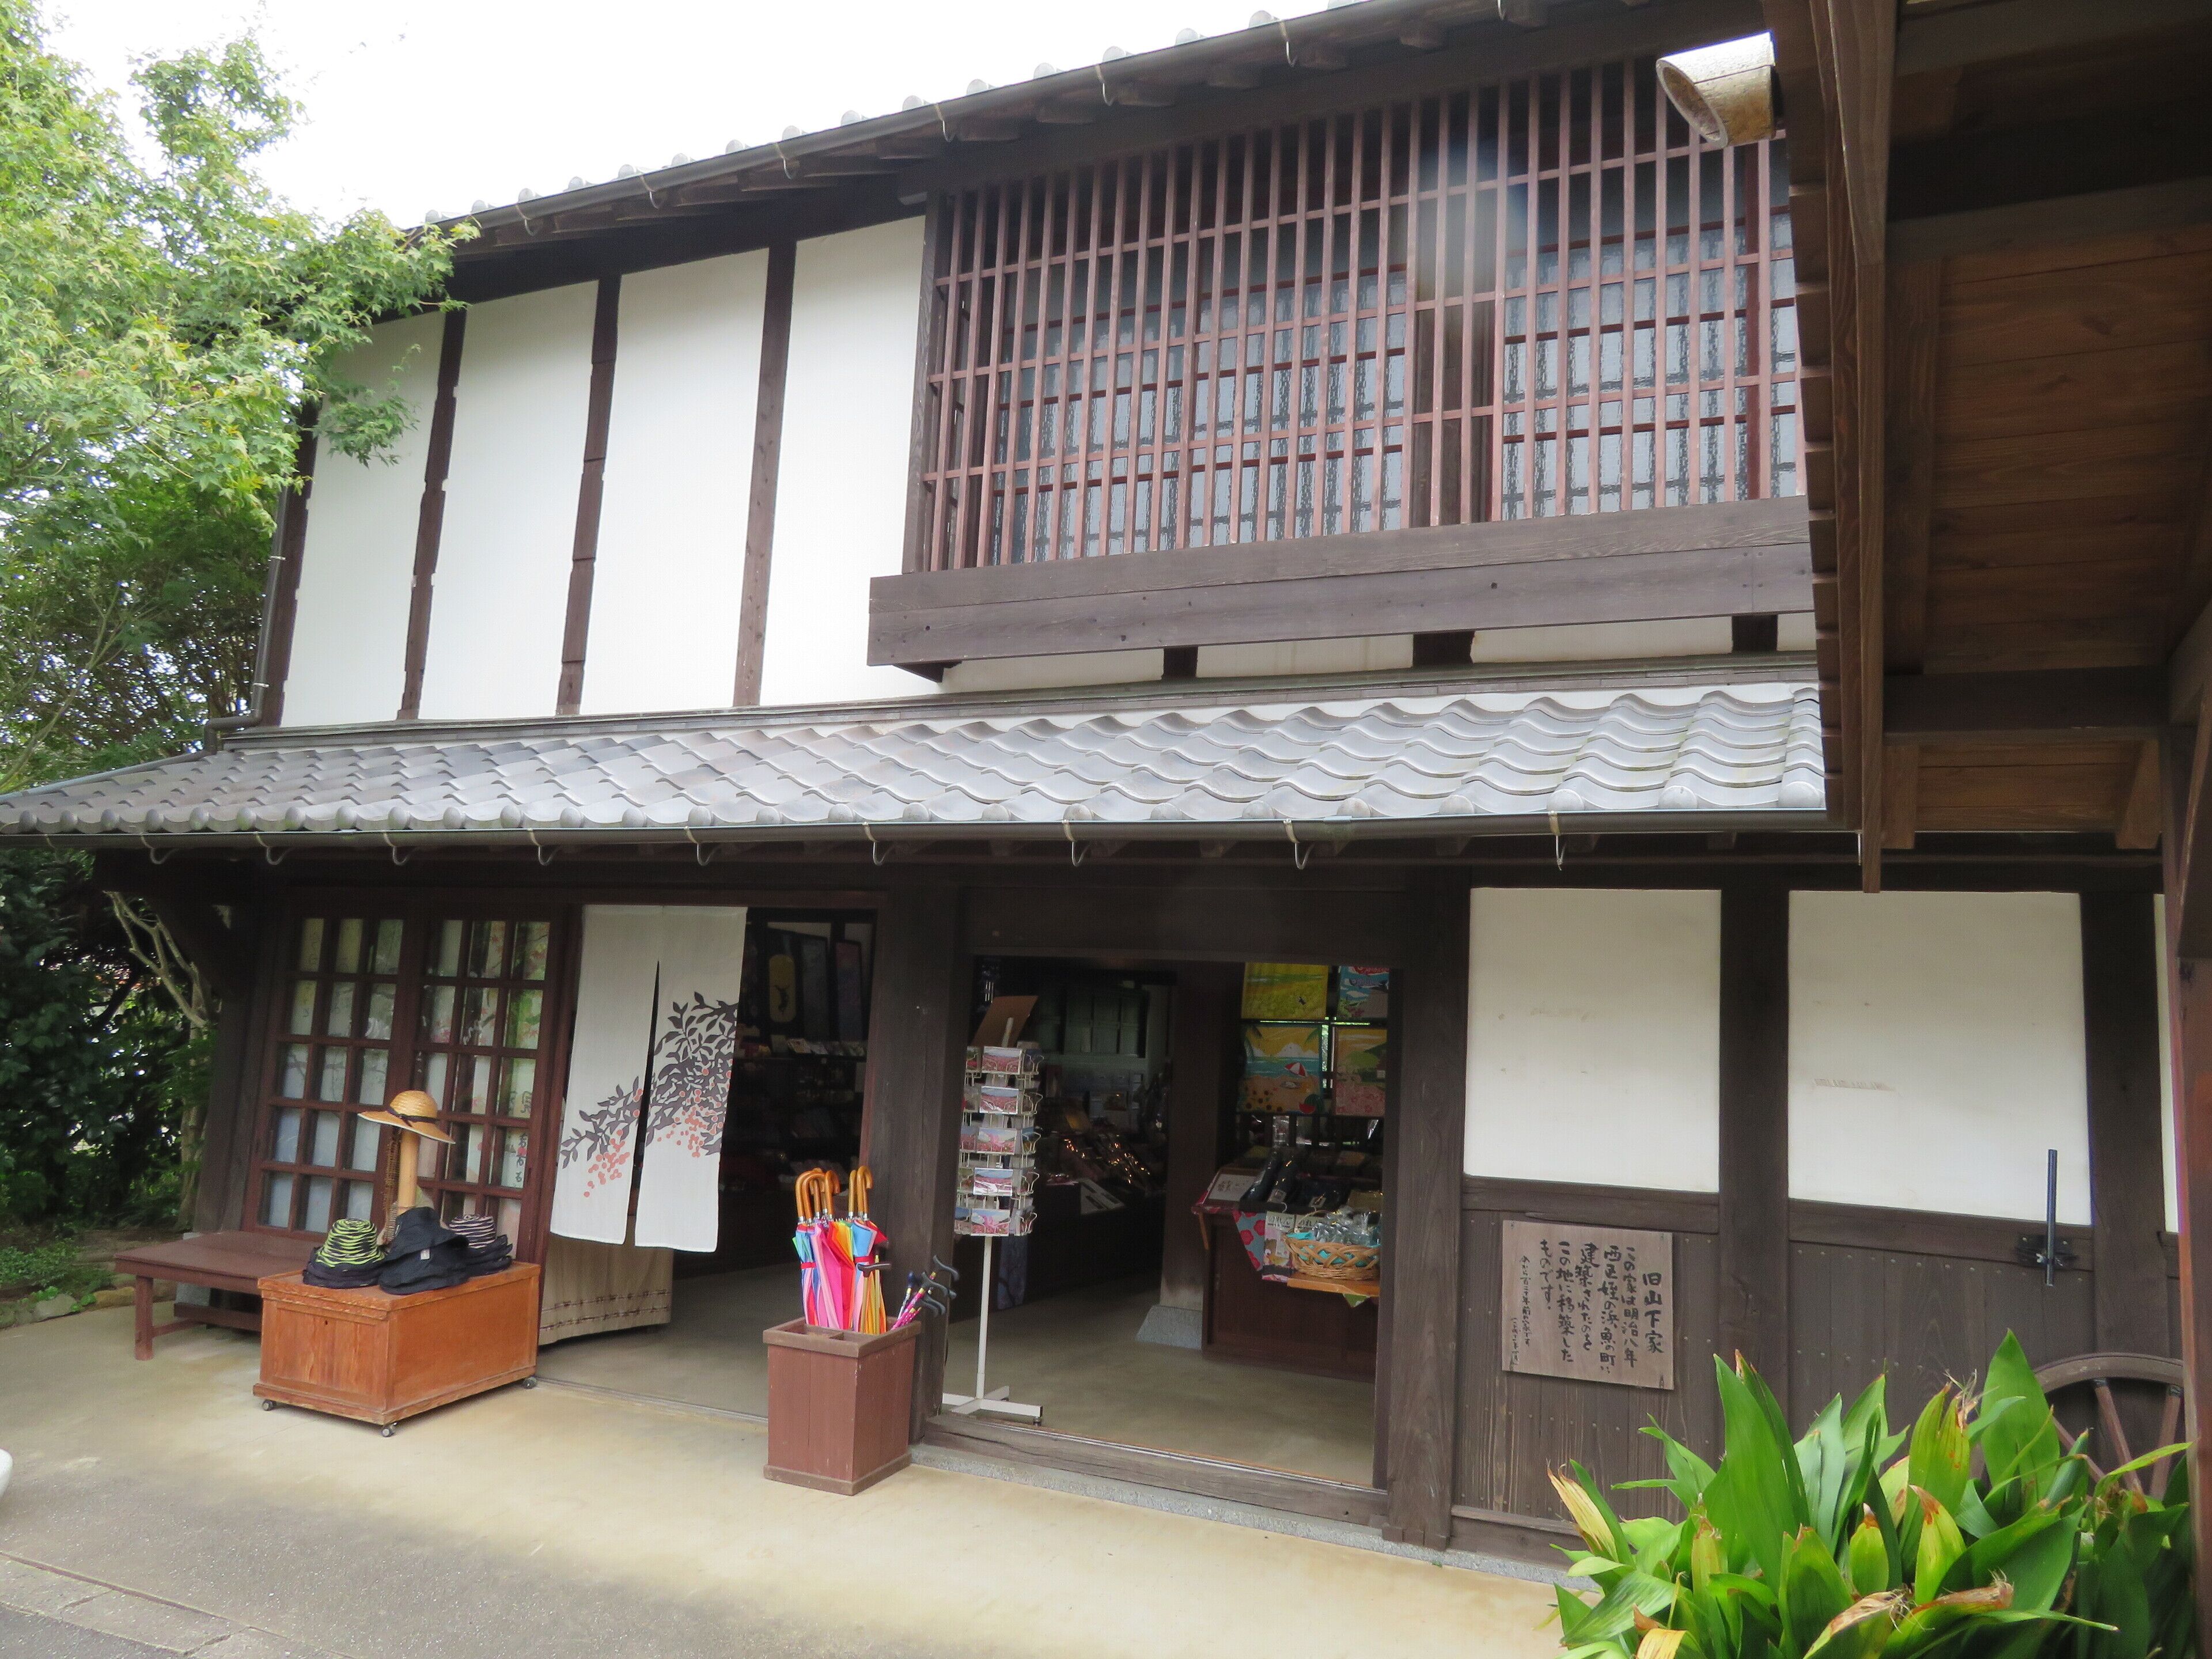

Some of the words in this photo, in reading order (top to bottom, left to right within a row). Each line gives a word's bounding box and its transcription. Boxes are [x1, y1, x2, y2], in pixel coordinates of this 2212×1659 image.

[1555, 1241, 1574, 1362] この地に移築した
[1575, 1242, 1600, 1351] 建築されたのを
[1620, 1247, 1639, 1368] この家は明治八年
[1643, 1272, 1664, 1353] 旧山下家
